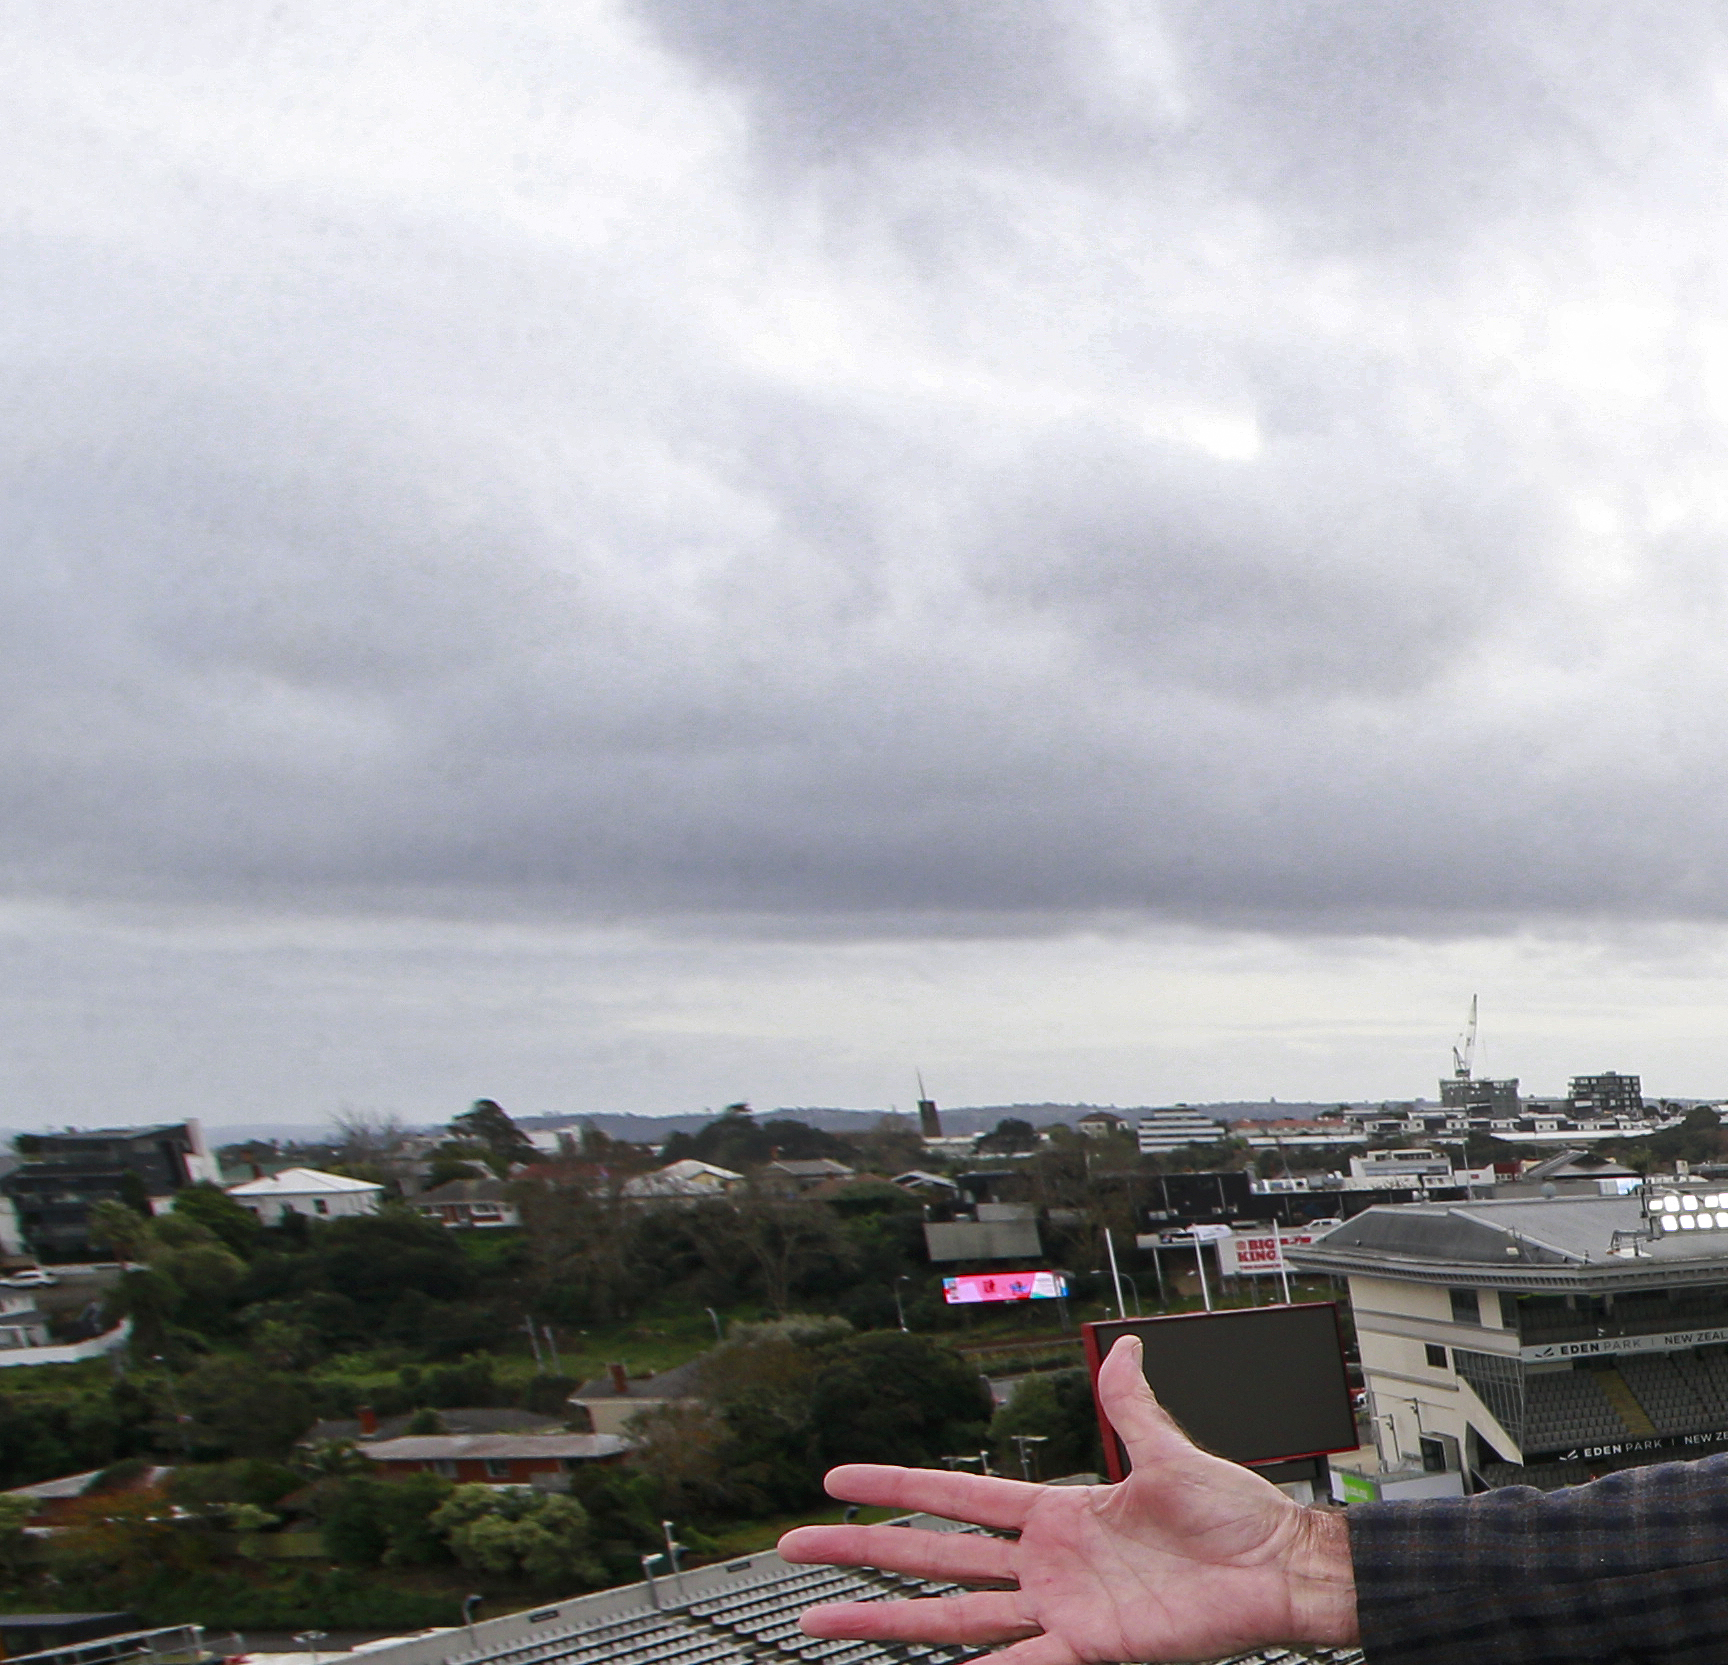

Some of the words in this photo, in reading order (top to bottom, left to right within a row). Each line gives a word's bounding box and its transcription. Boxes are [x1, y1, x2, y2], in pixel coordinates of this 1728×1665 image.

[1248, 1239, 1275, 1249] BIG
[1237, 1250, 1276, 1261] KING
[1560, 1343, 1599, 1356] EDEN
[1603, 1339, 1641, 1352] PARK
[1665, 1333, 1691, 1345] NEW
[1584, 1443, 1622, 1457] EDEN
[1626, 1439, 1662, 1452] PARK
[1685, 1432, 1712, 1444] NEW
